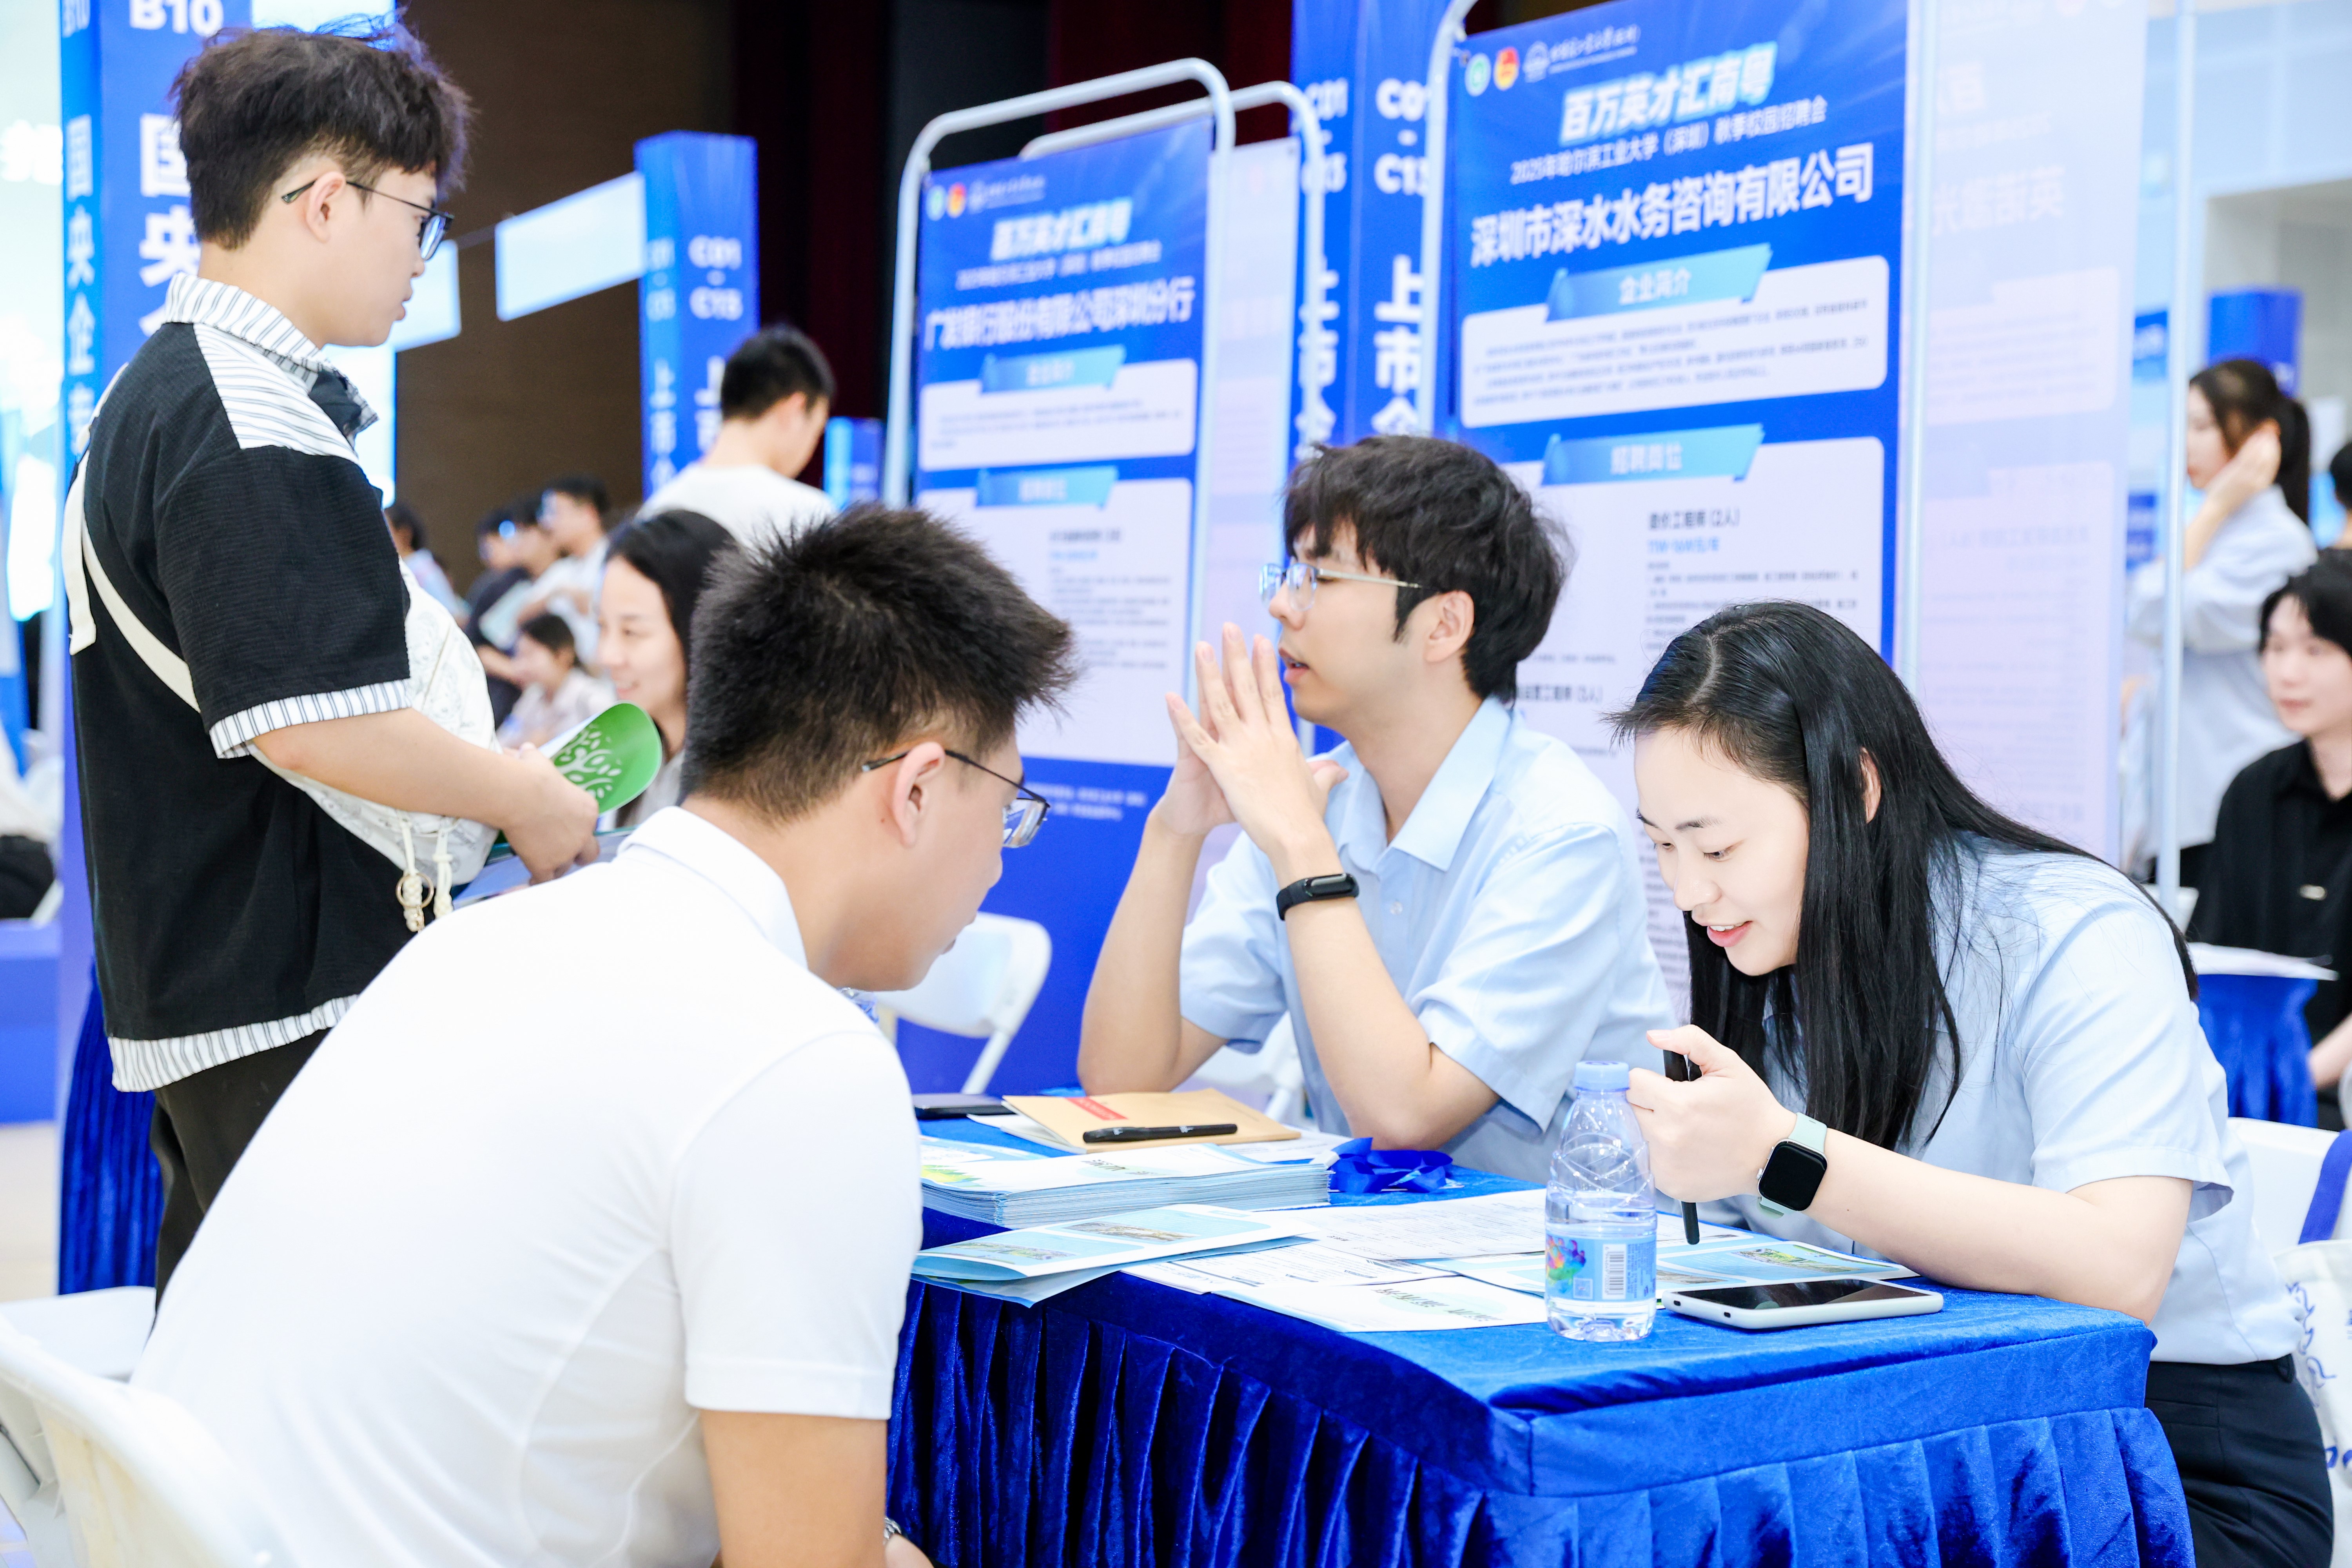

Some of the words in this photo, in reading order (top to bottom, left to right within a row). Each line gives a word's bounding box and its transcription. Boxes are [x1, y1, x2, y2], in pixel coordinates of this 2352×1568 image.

[1562, 44, 1776, 143] 百万英才汇南粤
[1469, 142, 1874, 268] 深圳市深水水务咨询有限公司
